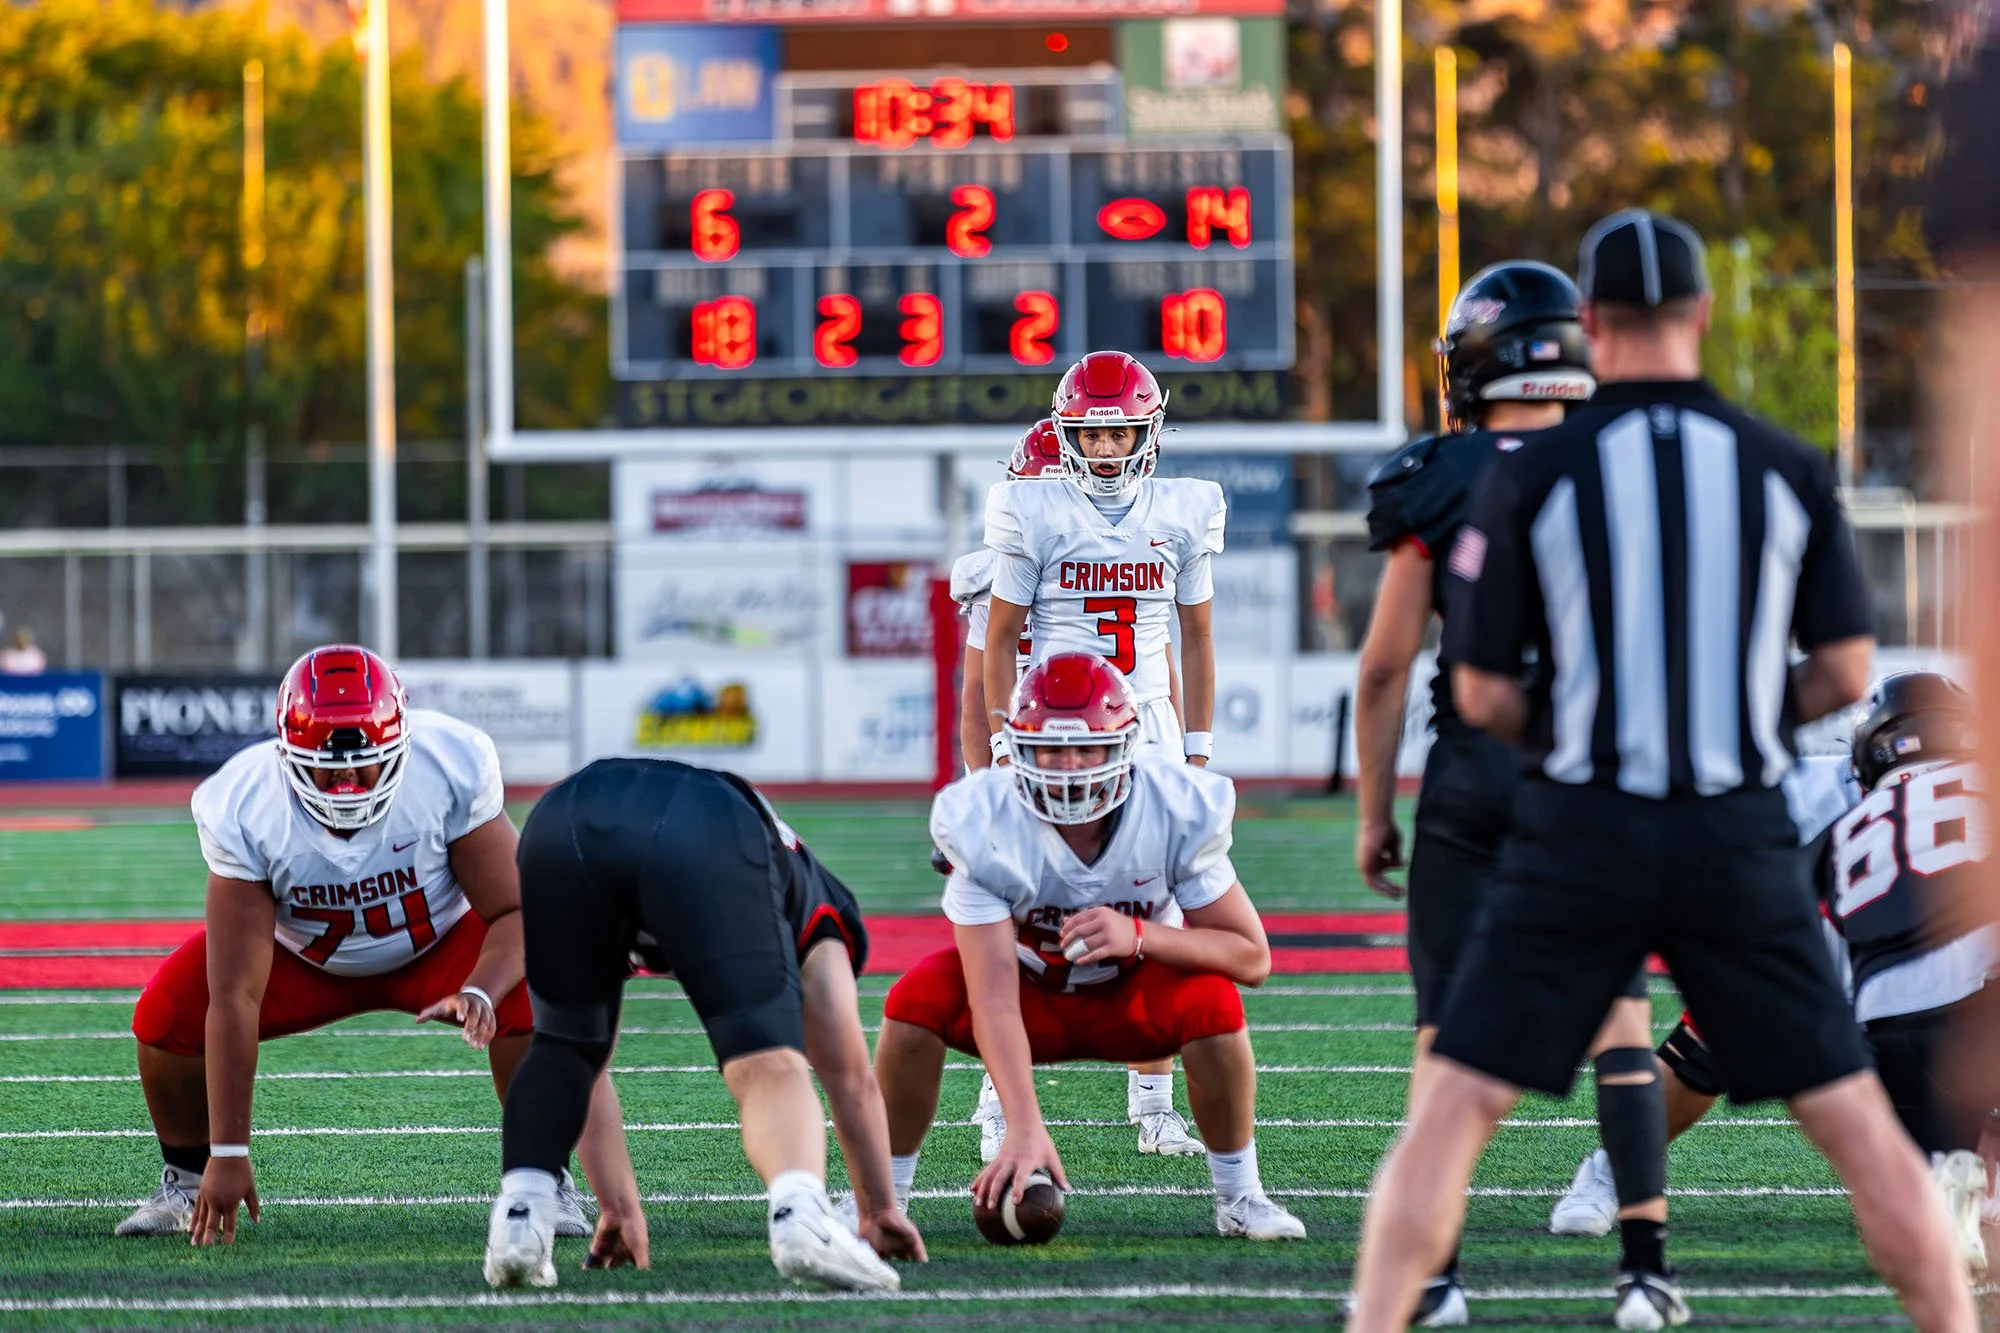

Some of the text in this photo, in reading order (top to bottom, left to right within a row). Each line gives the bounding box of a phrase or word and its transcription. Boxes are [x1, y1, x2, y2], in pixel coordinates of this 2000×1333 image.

[853, 77, 1015, 149] 10:34
[691, 188, 740, 262] 6
[946, 184, 996, 258] 2
[692, 295, 756, 370] 18
[814, 292, 943, 368] 2 3
[1009, 291, 1060, 366] 2
[1161, 288, 1227, 363] 10
[1521, 381, 1587, 397] Riddell
[1060, 561, 1165, 591] CRIMSON
[1083, 597, 1137, 676] 3
[1833, 761, 1991, 918] 66
[291, 866, 418, 907] CRIMSON
[289, 887, 438, 967] 74
